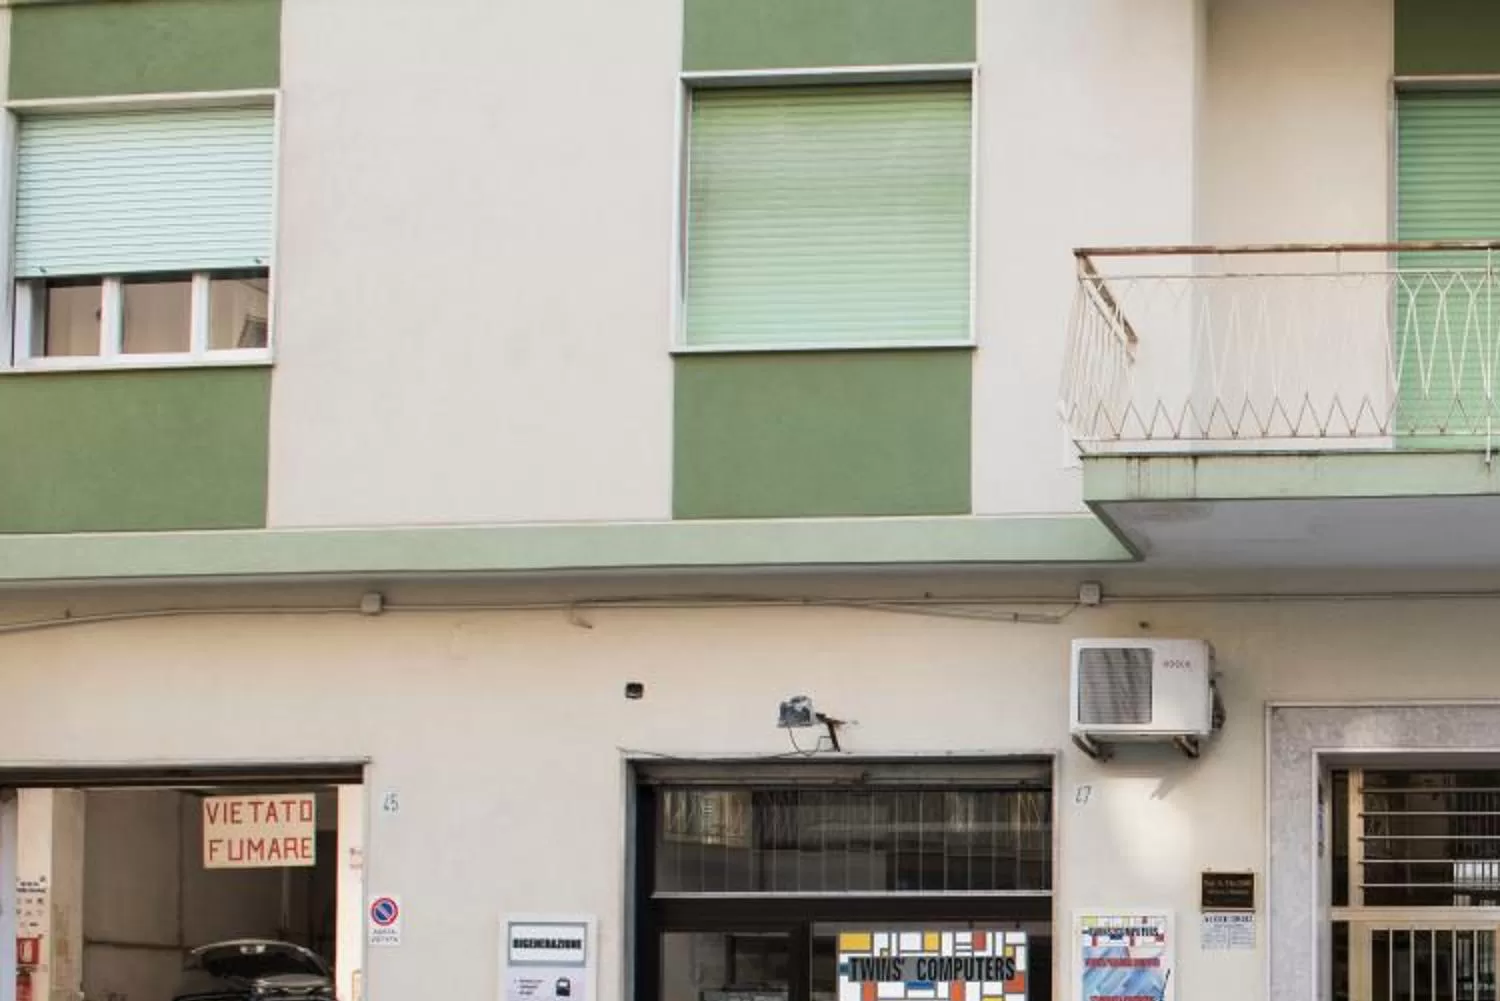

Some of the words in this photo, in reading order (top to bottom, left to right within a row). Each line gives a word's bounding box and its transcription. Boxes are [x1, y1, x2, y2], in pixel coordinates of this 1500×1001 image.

[206, 800, 313, 825] VIETATO
[208, 838, 313, 861] FUMARE
[916, 956, 1016, 981] COMPUTERS
